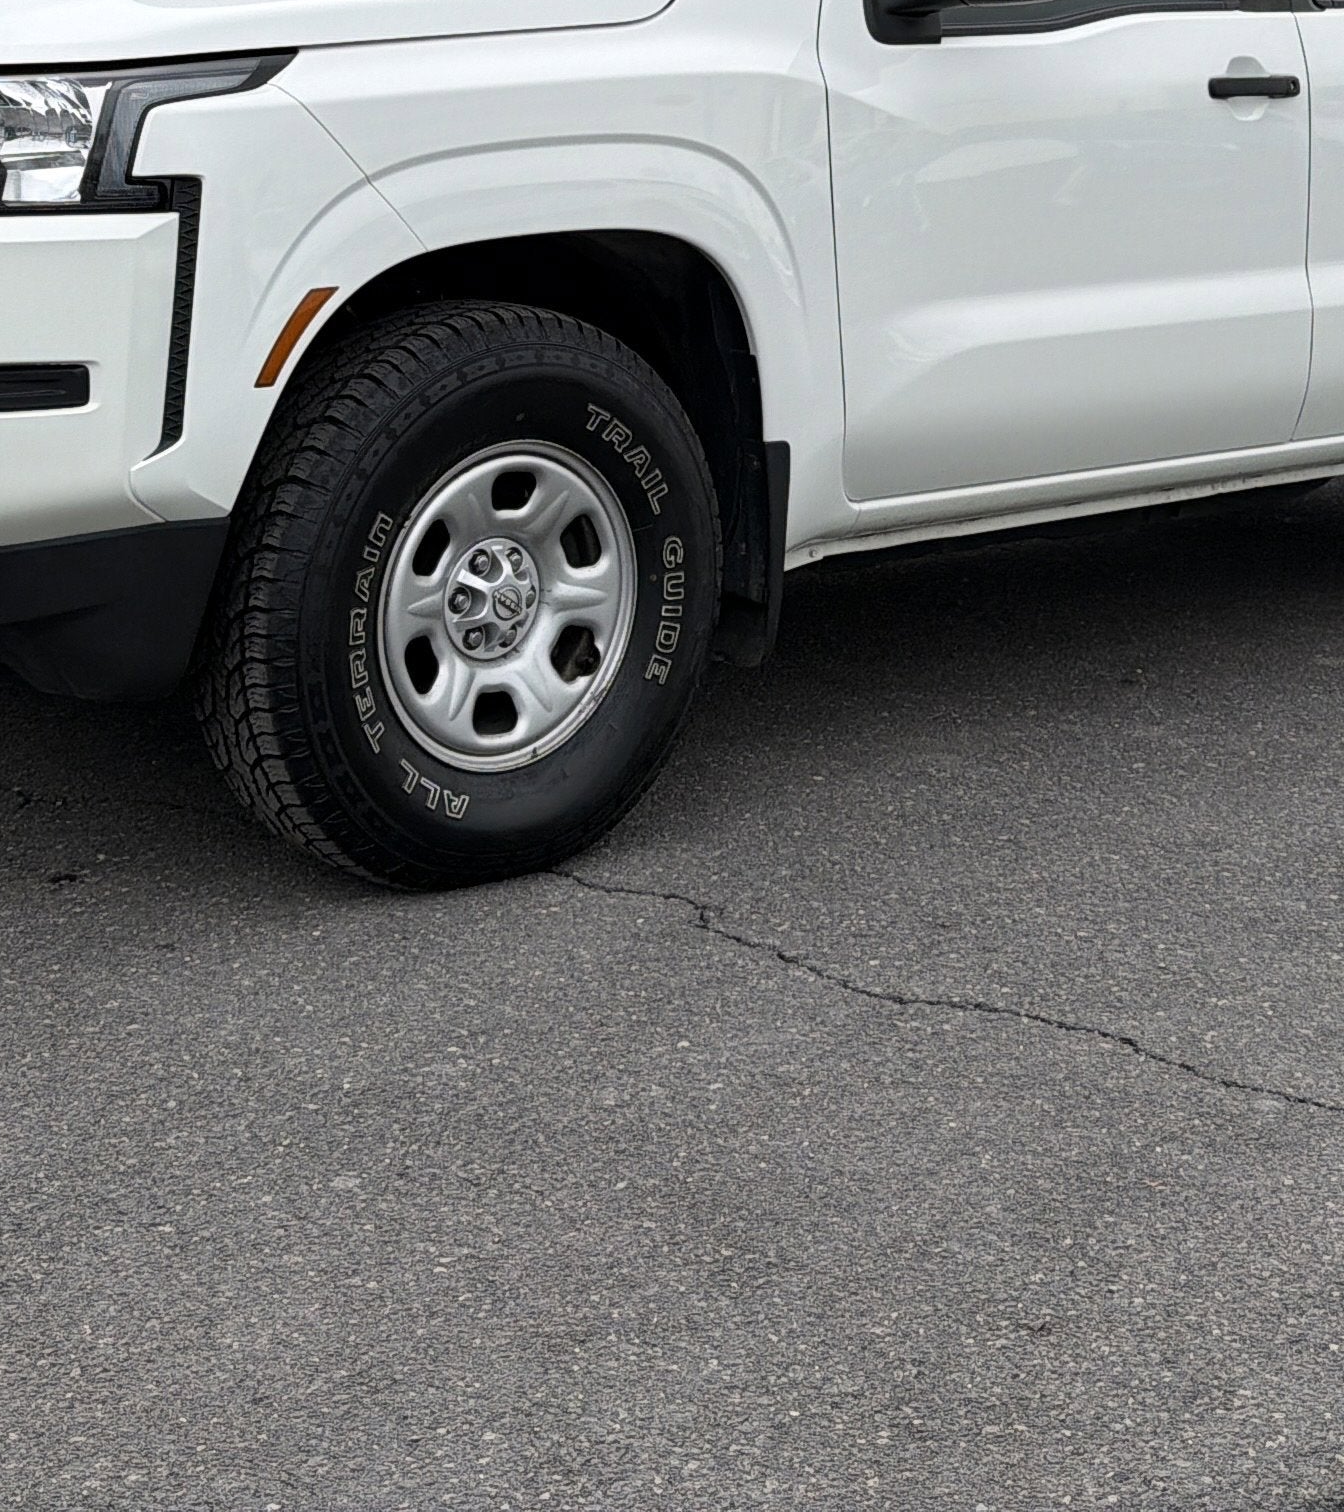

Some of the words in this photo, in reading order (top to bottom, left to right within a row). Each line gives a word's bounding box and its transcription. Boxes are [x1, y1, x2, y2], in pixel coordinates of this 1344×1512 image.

[349, 512, 393, 753] TERRAIN
[586, 403, 669, 515] TRAIL
[645, 536, 685, 685] GUIDE
[400, 758, 469, 819] ALL
